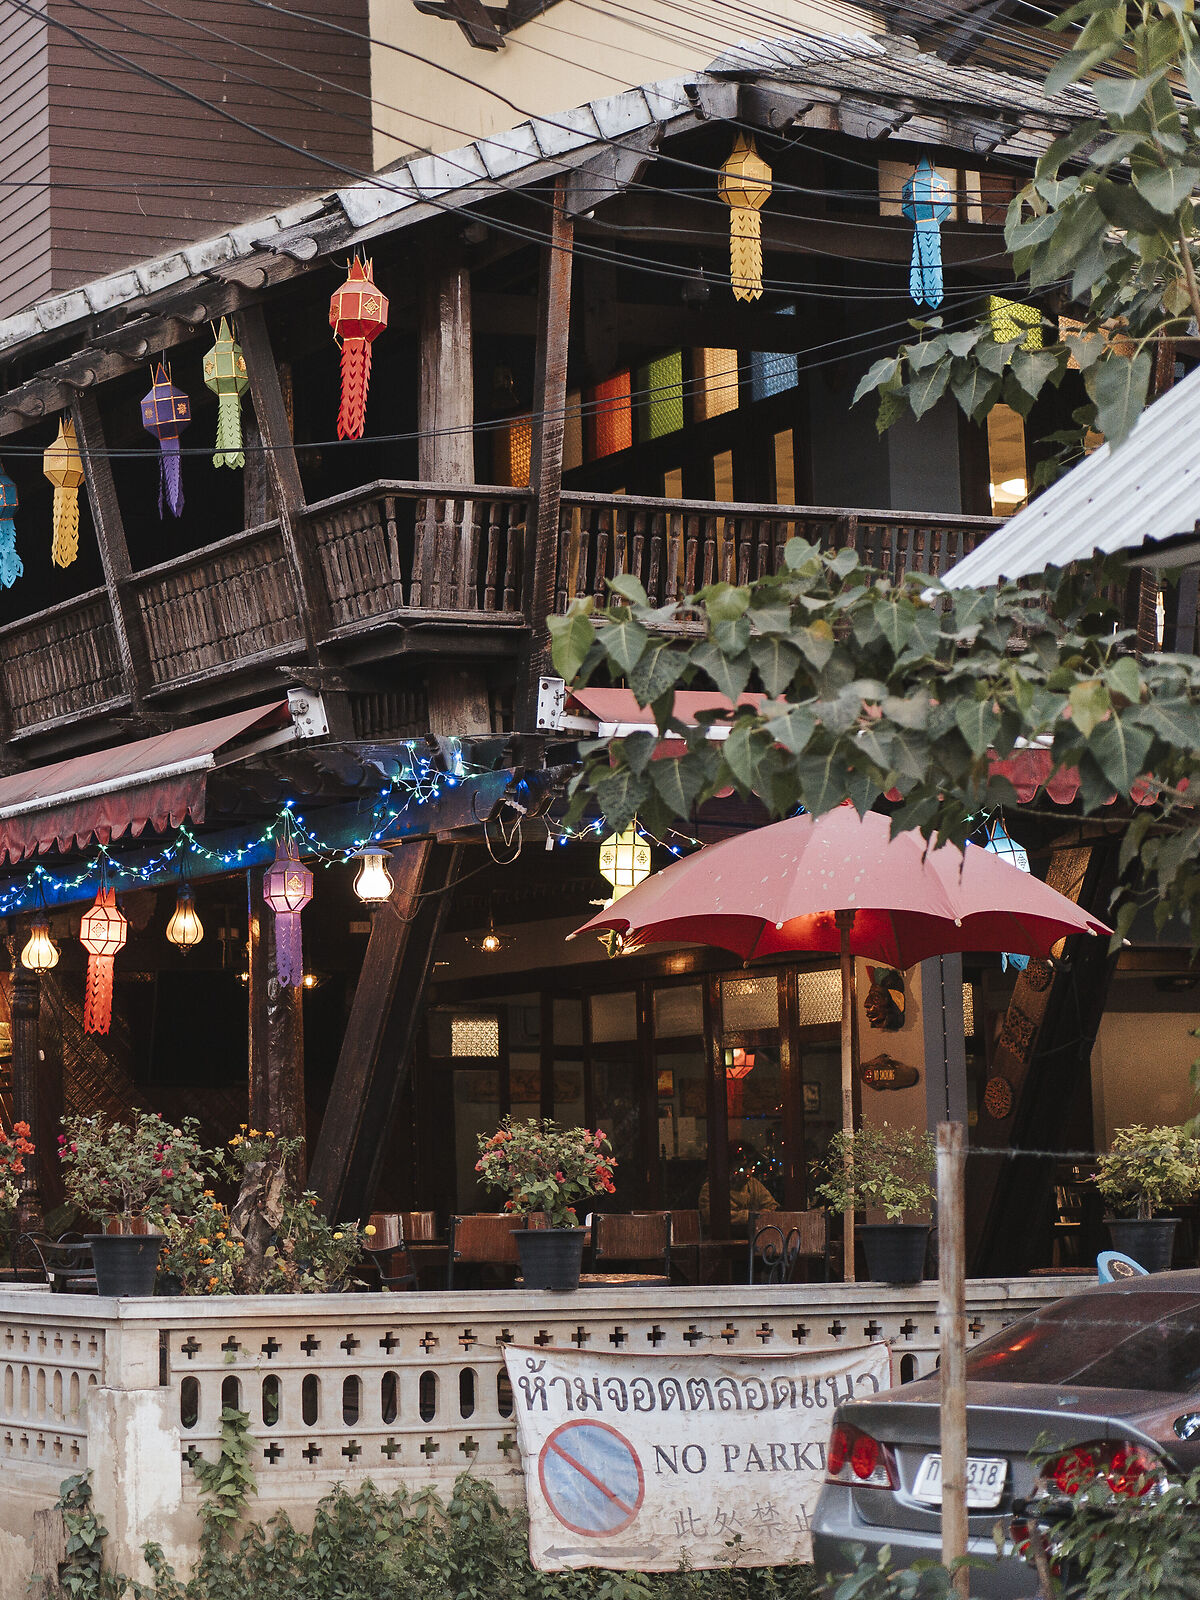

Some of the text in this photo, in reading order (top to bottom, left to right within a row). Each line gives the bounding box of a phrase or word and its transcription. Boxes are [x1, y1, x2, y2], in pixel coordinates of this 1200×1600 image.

[652, 1441, 827, 1474] NO PARKI
[674, 1500, 813, 1539] 此处禁止
